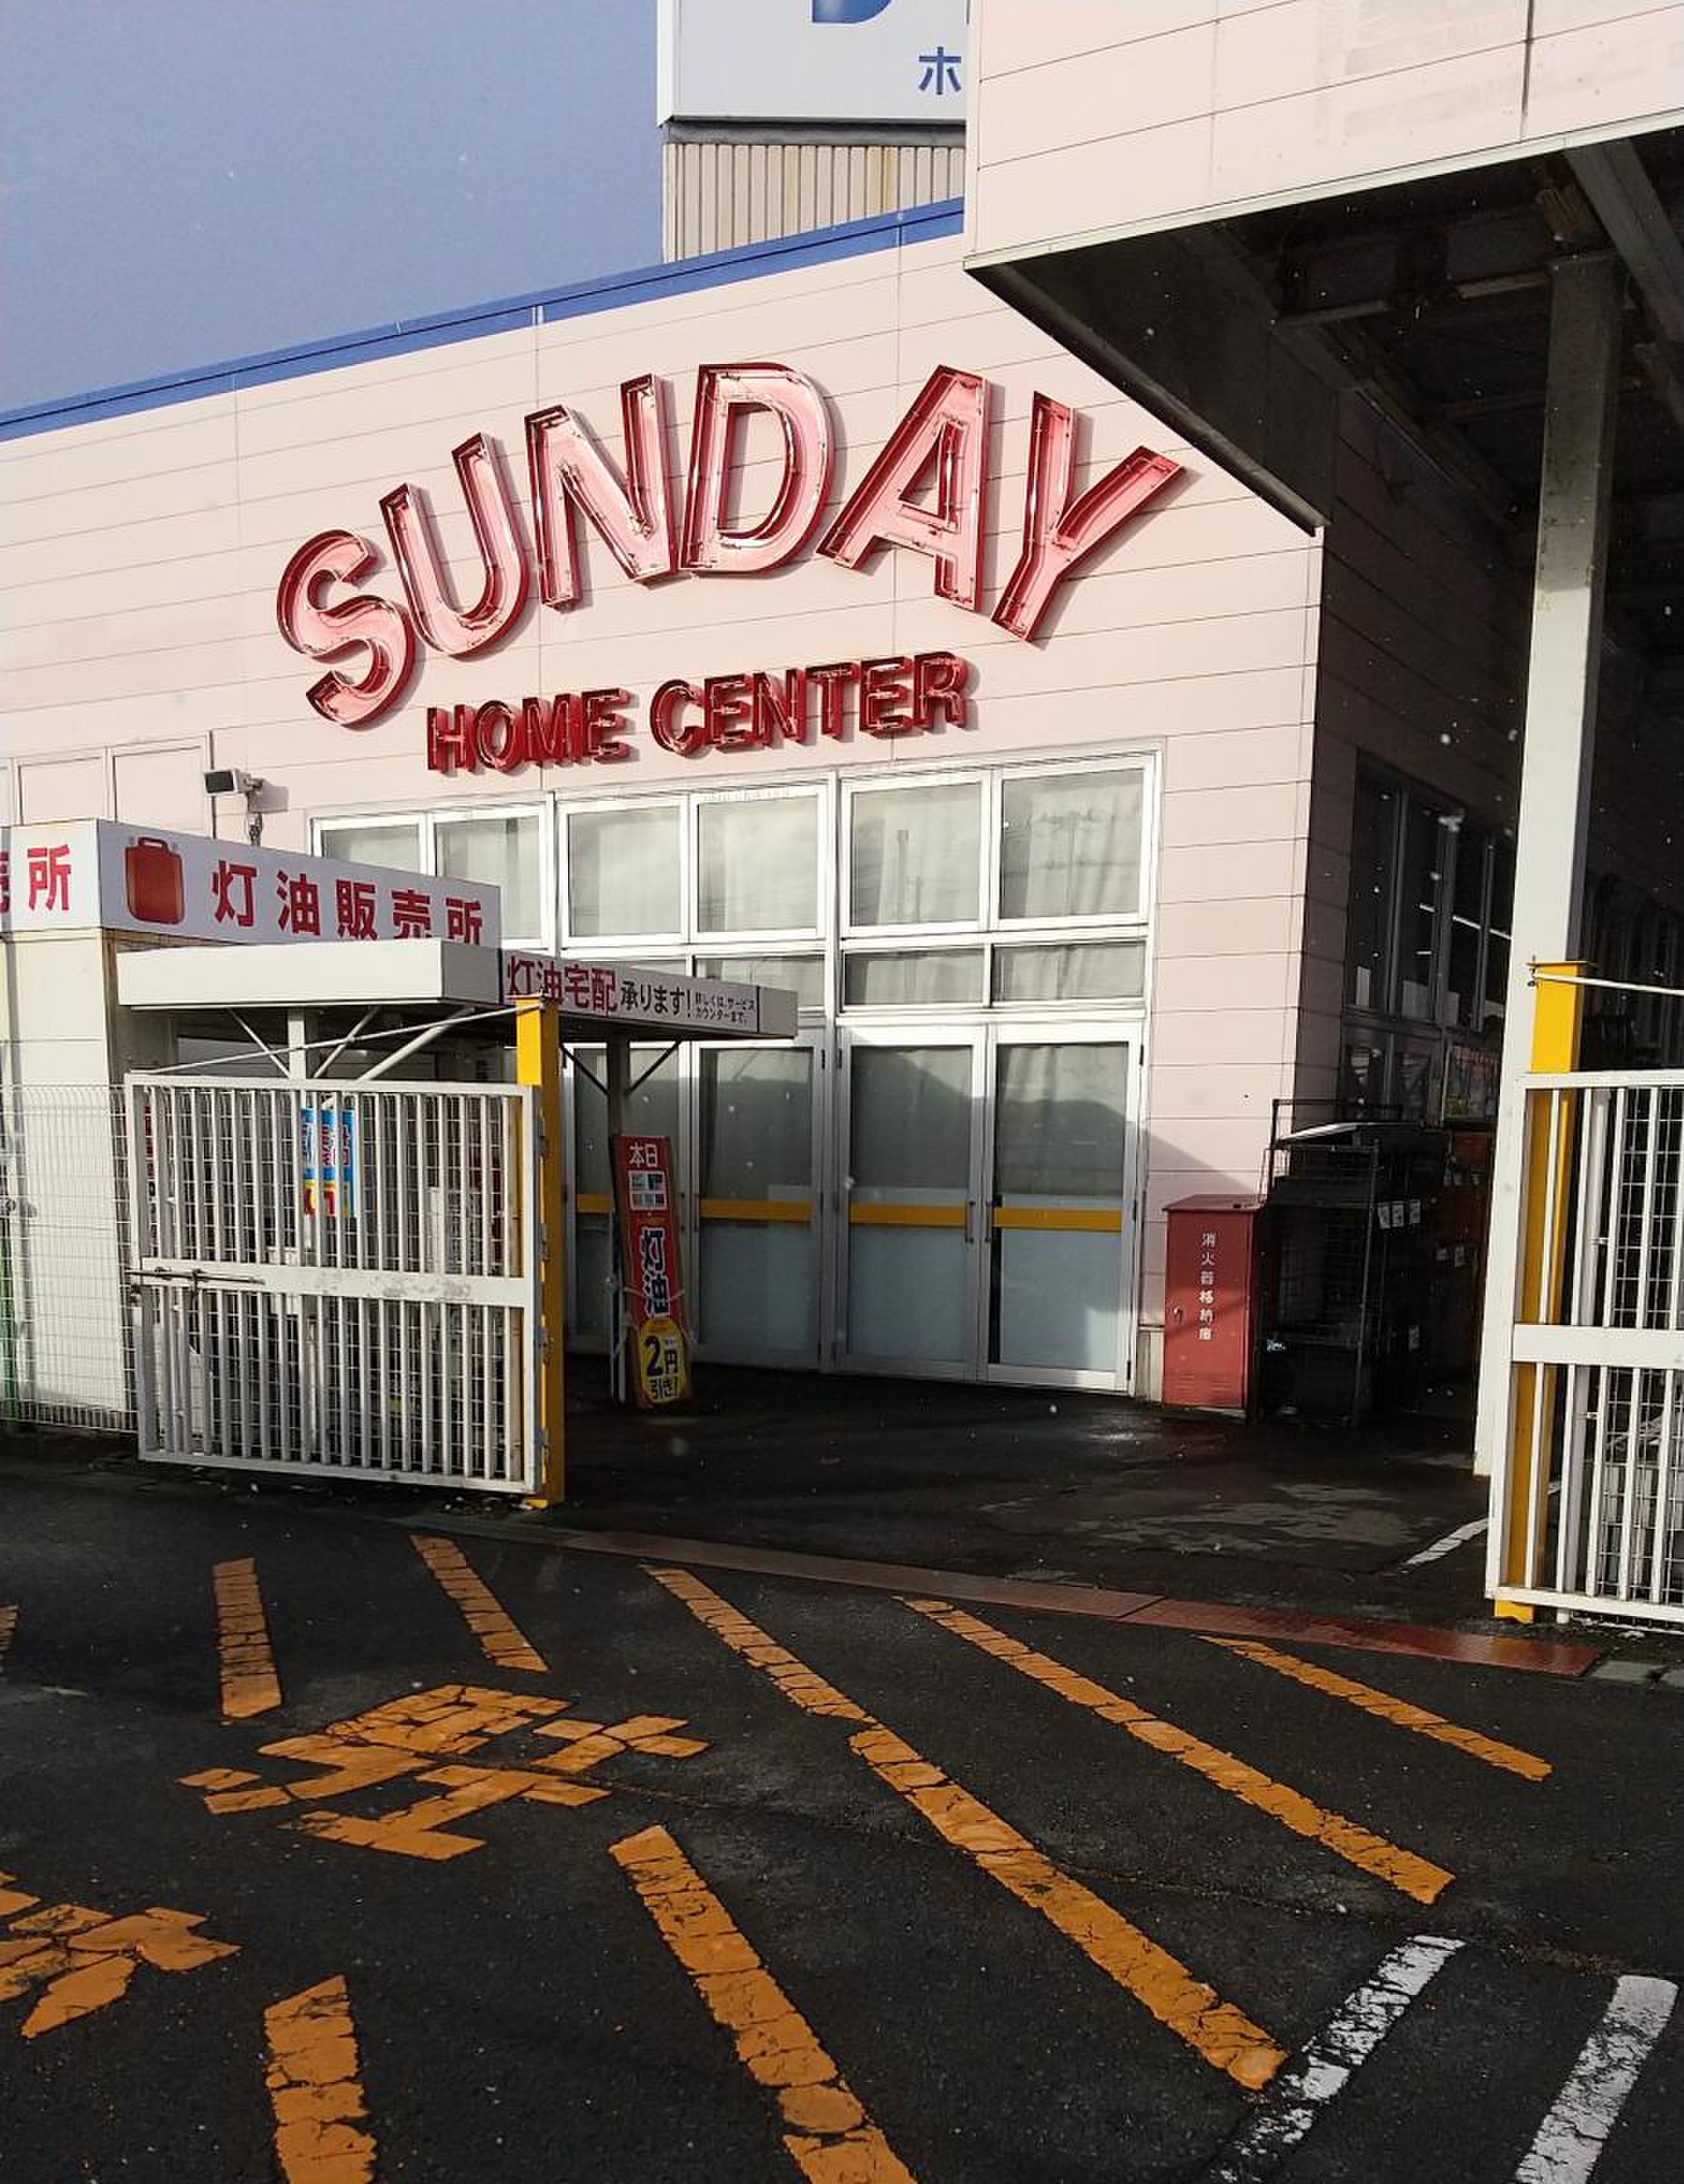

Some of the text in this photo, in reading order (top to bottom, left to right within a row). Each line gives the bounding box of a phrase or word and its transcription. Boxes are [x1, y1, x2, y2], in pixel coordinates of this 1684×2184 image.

[918, 46, 962, 96] ホ
[277, 362, 1182, 726] SUNDAY
[428, 652, 970, 774] HOME CENTER
[0, 844, 72, 913] 所
[213, 859, 484, 946] 灯油販売所
[629, 1142, 658, 1168] 本日
[640, 1227, 671, 1318] 灯油
